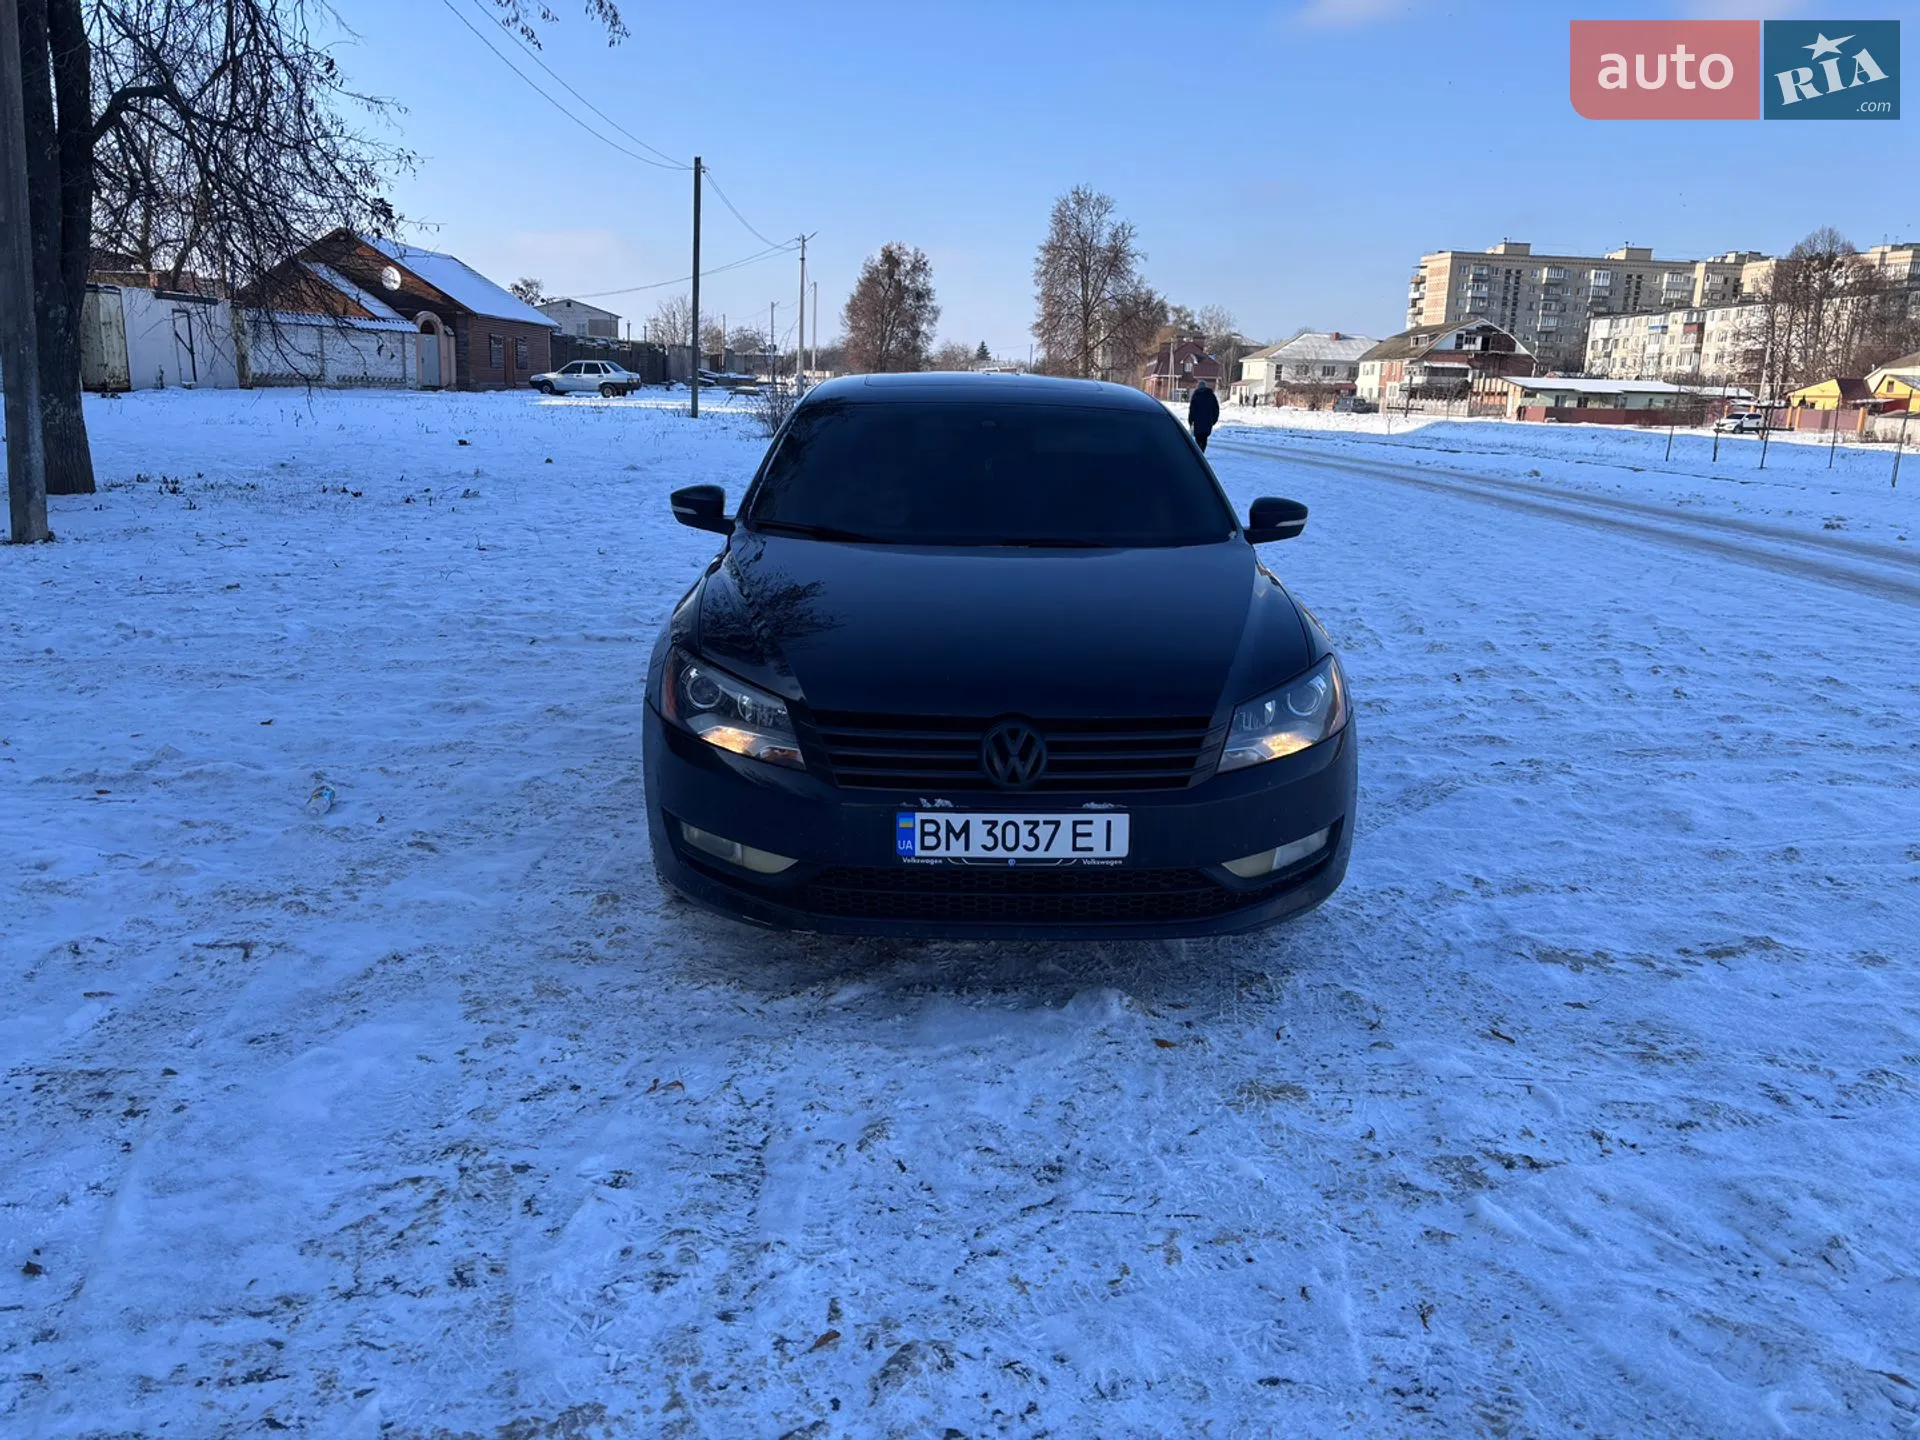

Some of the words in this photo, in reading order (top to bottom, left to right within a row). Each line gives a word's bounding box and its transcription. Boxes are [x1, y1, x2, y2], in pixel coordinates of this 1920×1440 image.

[919, 818, 971, 852] BM
[980, 819, 1062, 852] 3037
[1071, 819, 1112, 852] EI
[898, 840, 913, 851] UA
[902, 856, 943, 866] Volkswagen
[1082, 857, 1123, 867] Volkswagen
